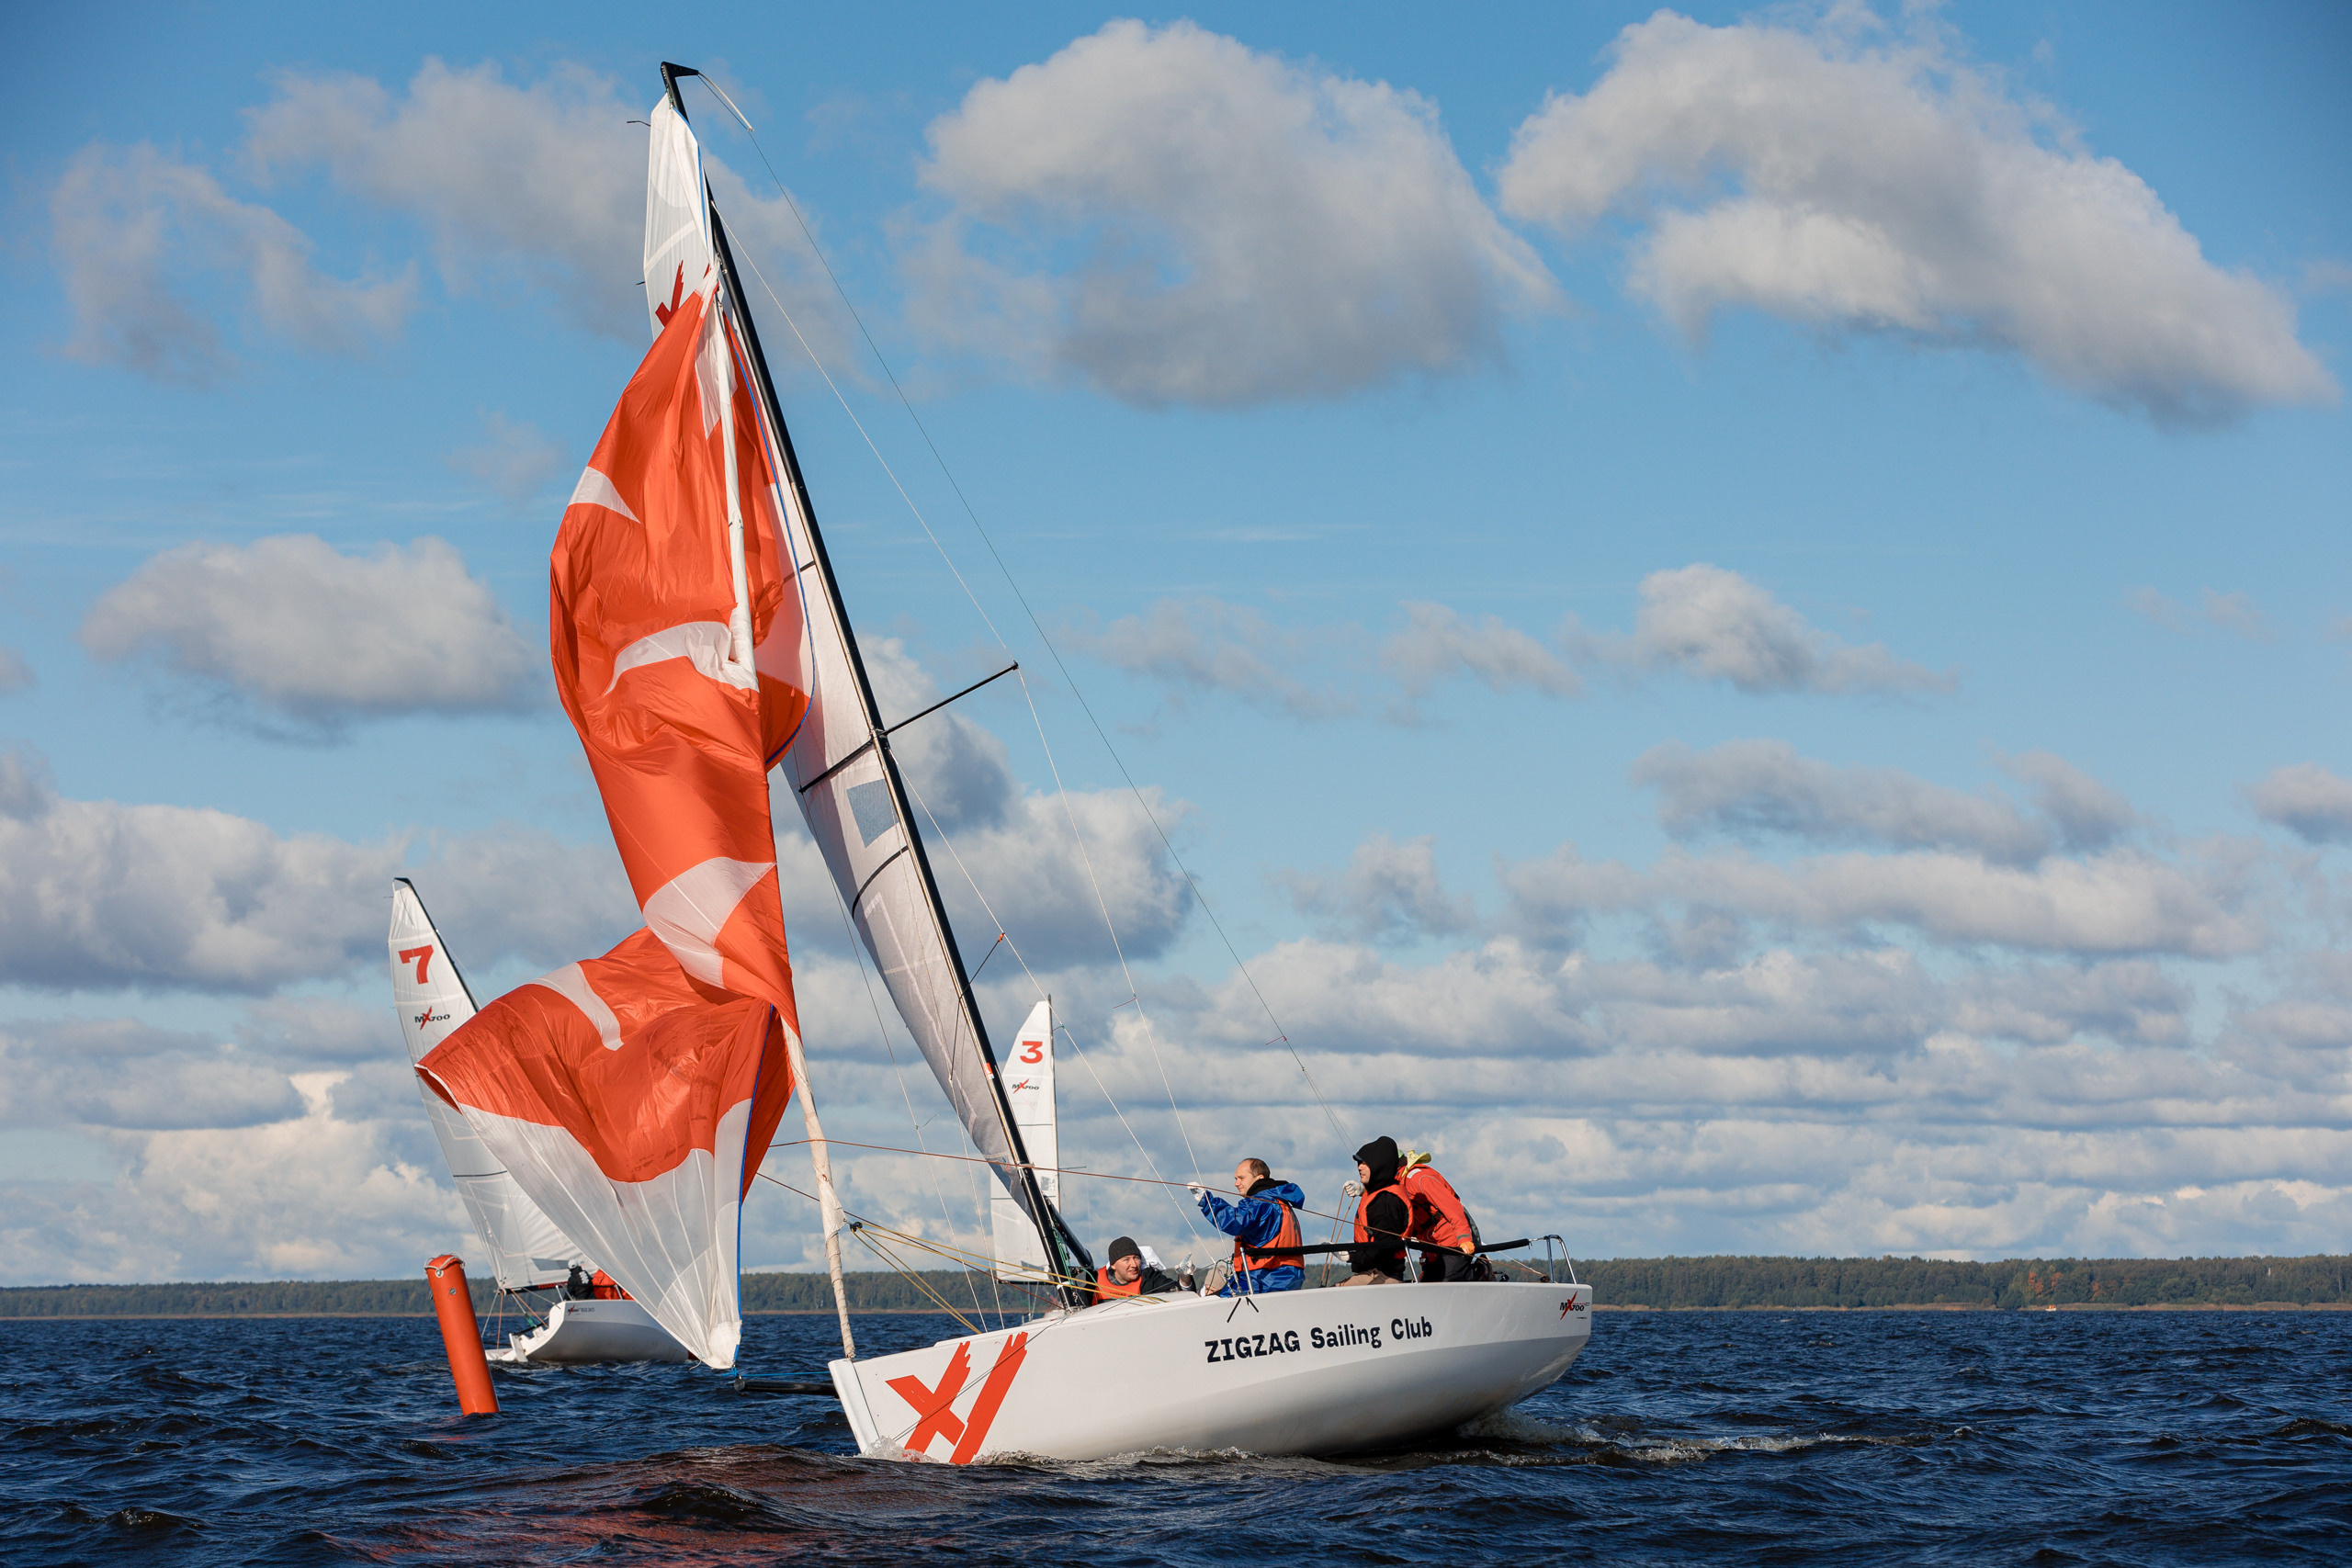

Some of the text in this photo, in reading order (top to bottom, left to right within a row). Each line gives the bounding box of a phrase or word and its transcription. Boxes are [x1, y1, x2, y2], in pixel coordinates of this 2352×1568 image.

[398, 944, 434, 985] 7
[414, 1006, 450, 1030] MX700
[1020, 1041, 1043, 1064] 3
[1012, 1078, 1039, 1094] MX700
[1559, 1290, 1585, 1321] MX700
[1204, 1316, 1432, 1363] ZIGZAG Sailing Club
